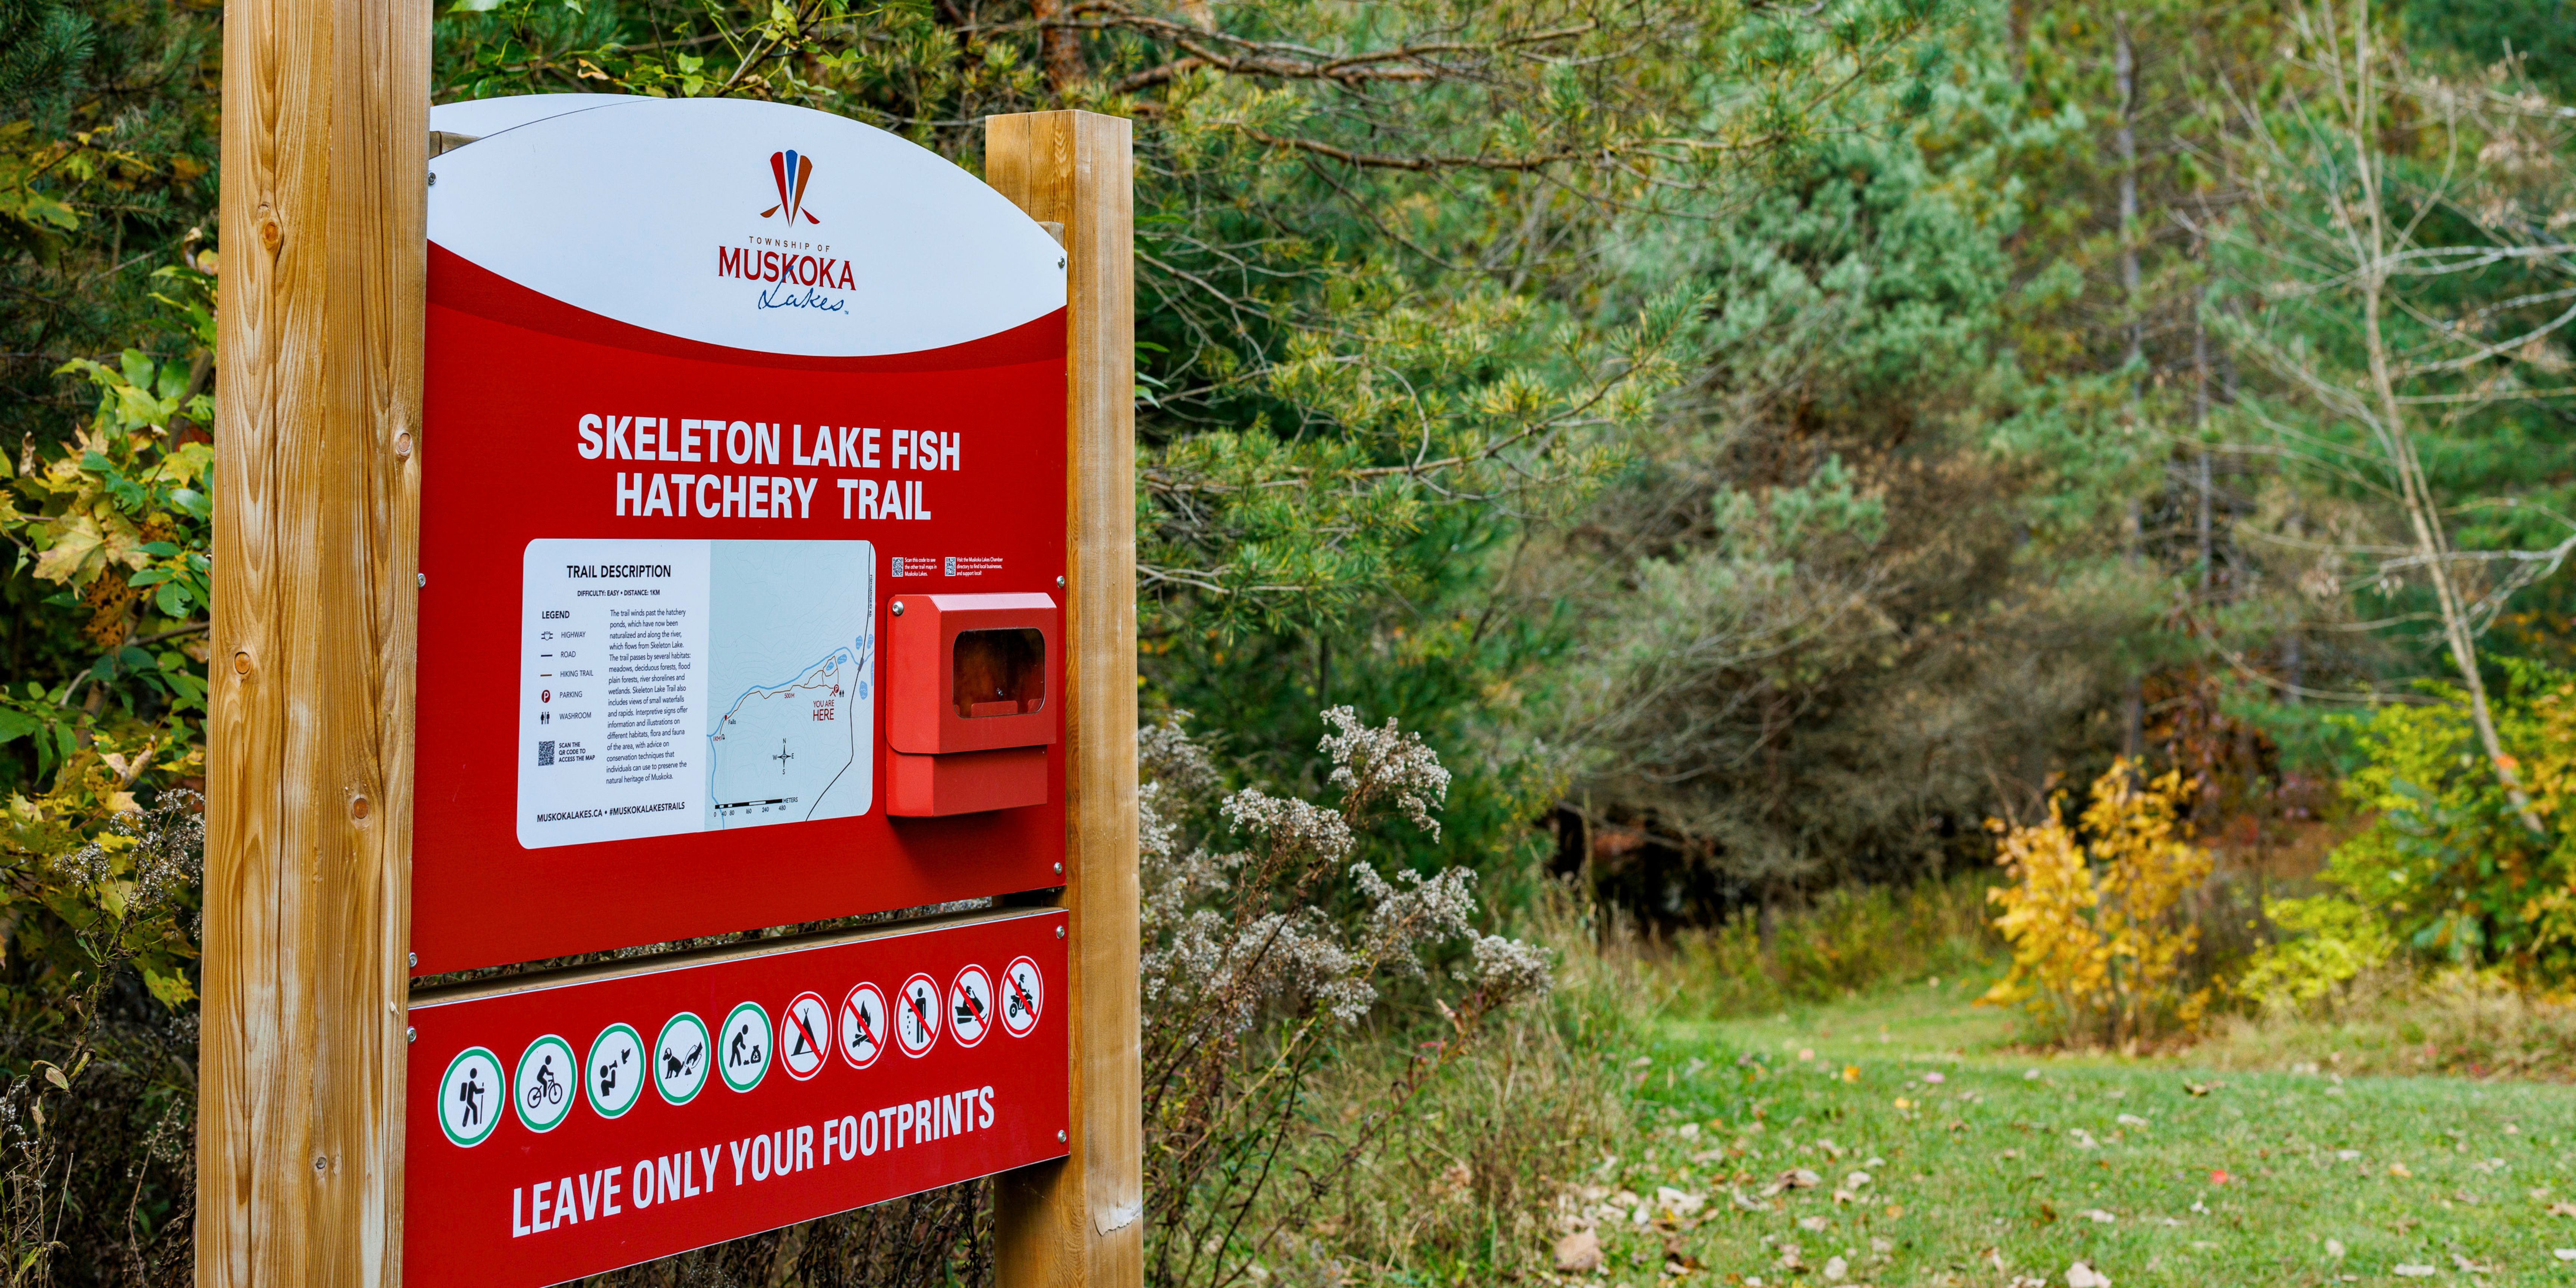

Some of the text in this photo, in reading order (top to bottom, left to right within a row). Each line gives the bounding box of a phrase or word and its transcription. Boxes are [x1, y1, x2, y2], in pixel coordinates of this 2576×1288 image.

[749, 236, 809, 249] TOWNSHIP
[719, 246, 856, 290] MUSKOKA
[758, 265, 844, 311] Lakes
[578, 414, 960, 471] SKELETON LAKE FISH
[616, 473, 931, 520] HATCHERY TRAIL
[567, 565, 670, 578] TRAIL DESCRIPTION
[666, 608, 686, 617] hatchery
[610, 621, 626, 629] ponds,
[648, 631, 660, 639] along
[647, 653, 653, 662] by
[609, 676, 620, 685] plain
[619, 709, 634, 718] rapids.
[636, 708, 663, 717] Interpretive
[664, 707, 676, 716] signs
[813, 708, 834, 721] HERE
[607, 754, 637, 762] conservation
[607, 764, 631, 773] individuals
[537, 802, 685, 822] MUSKOKALAKES.CA #MUSKOKALAKESTRAILS
[513, 1086, 994, 1238] LEAVE ONLY YOUR FOOTPRINTS
